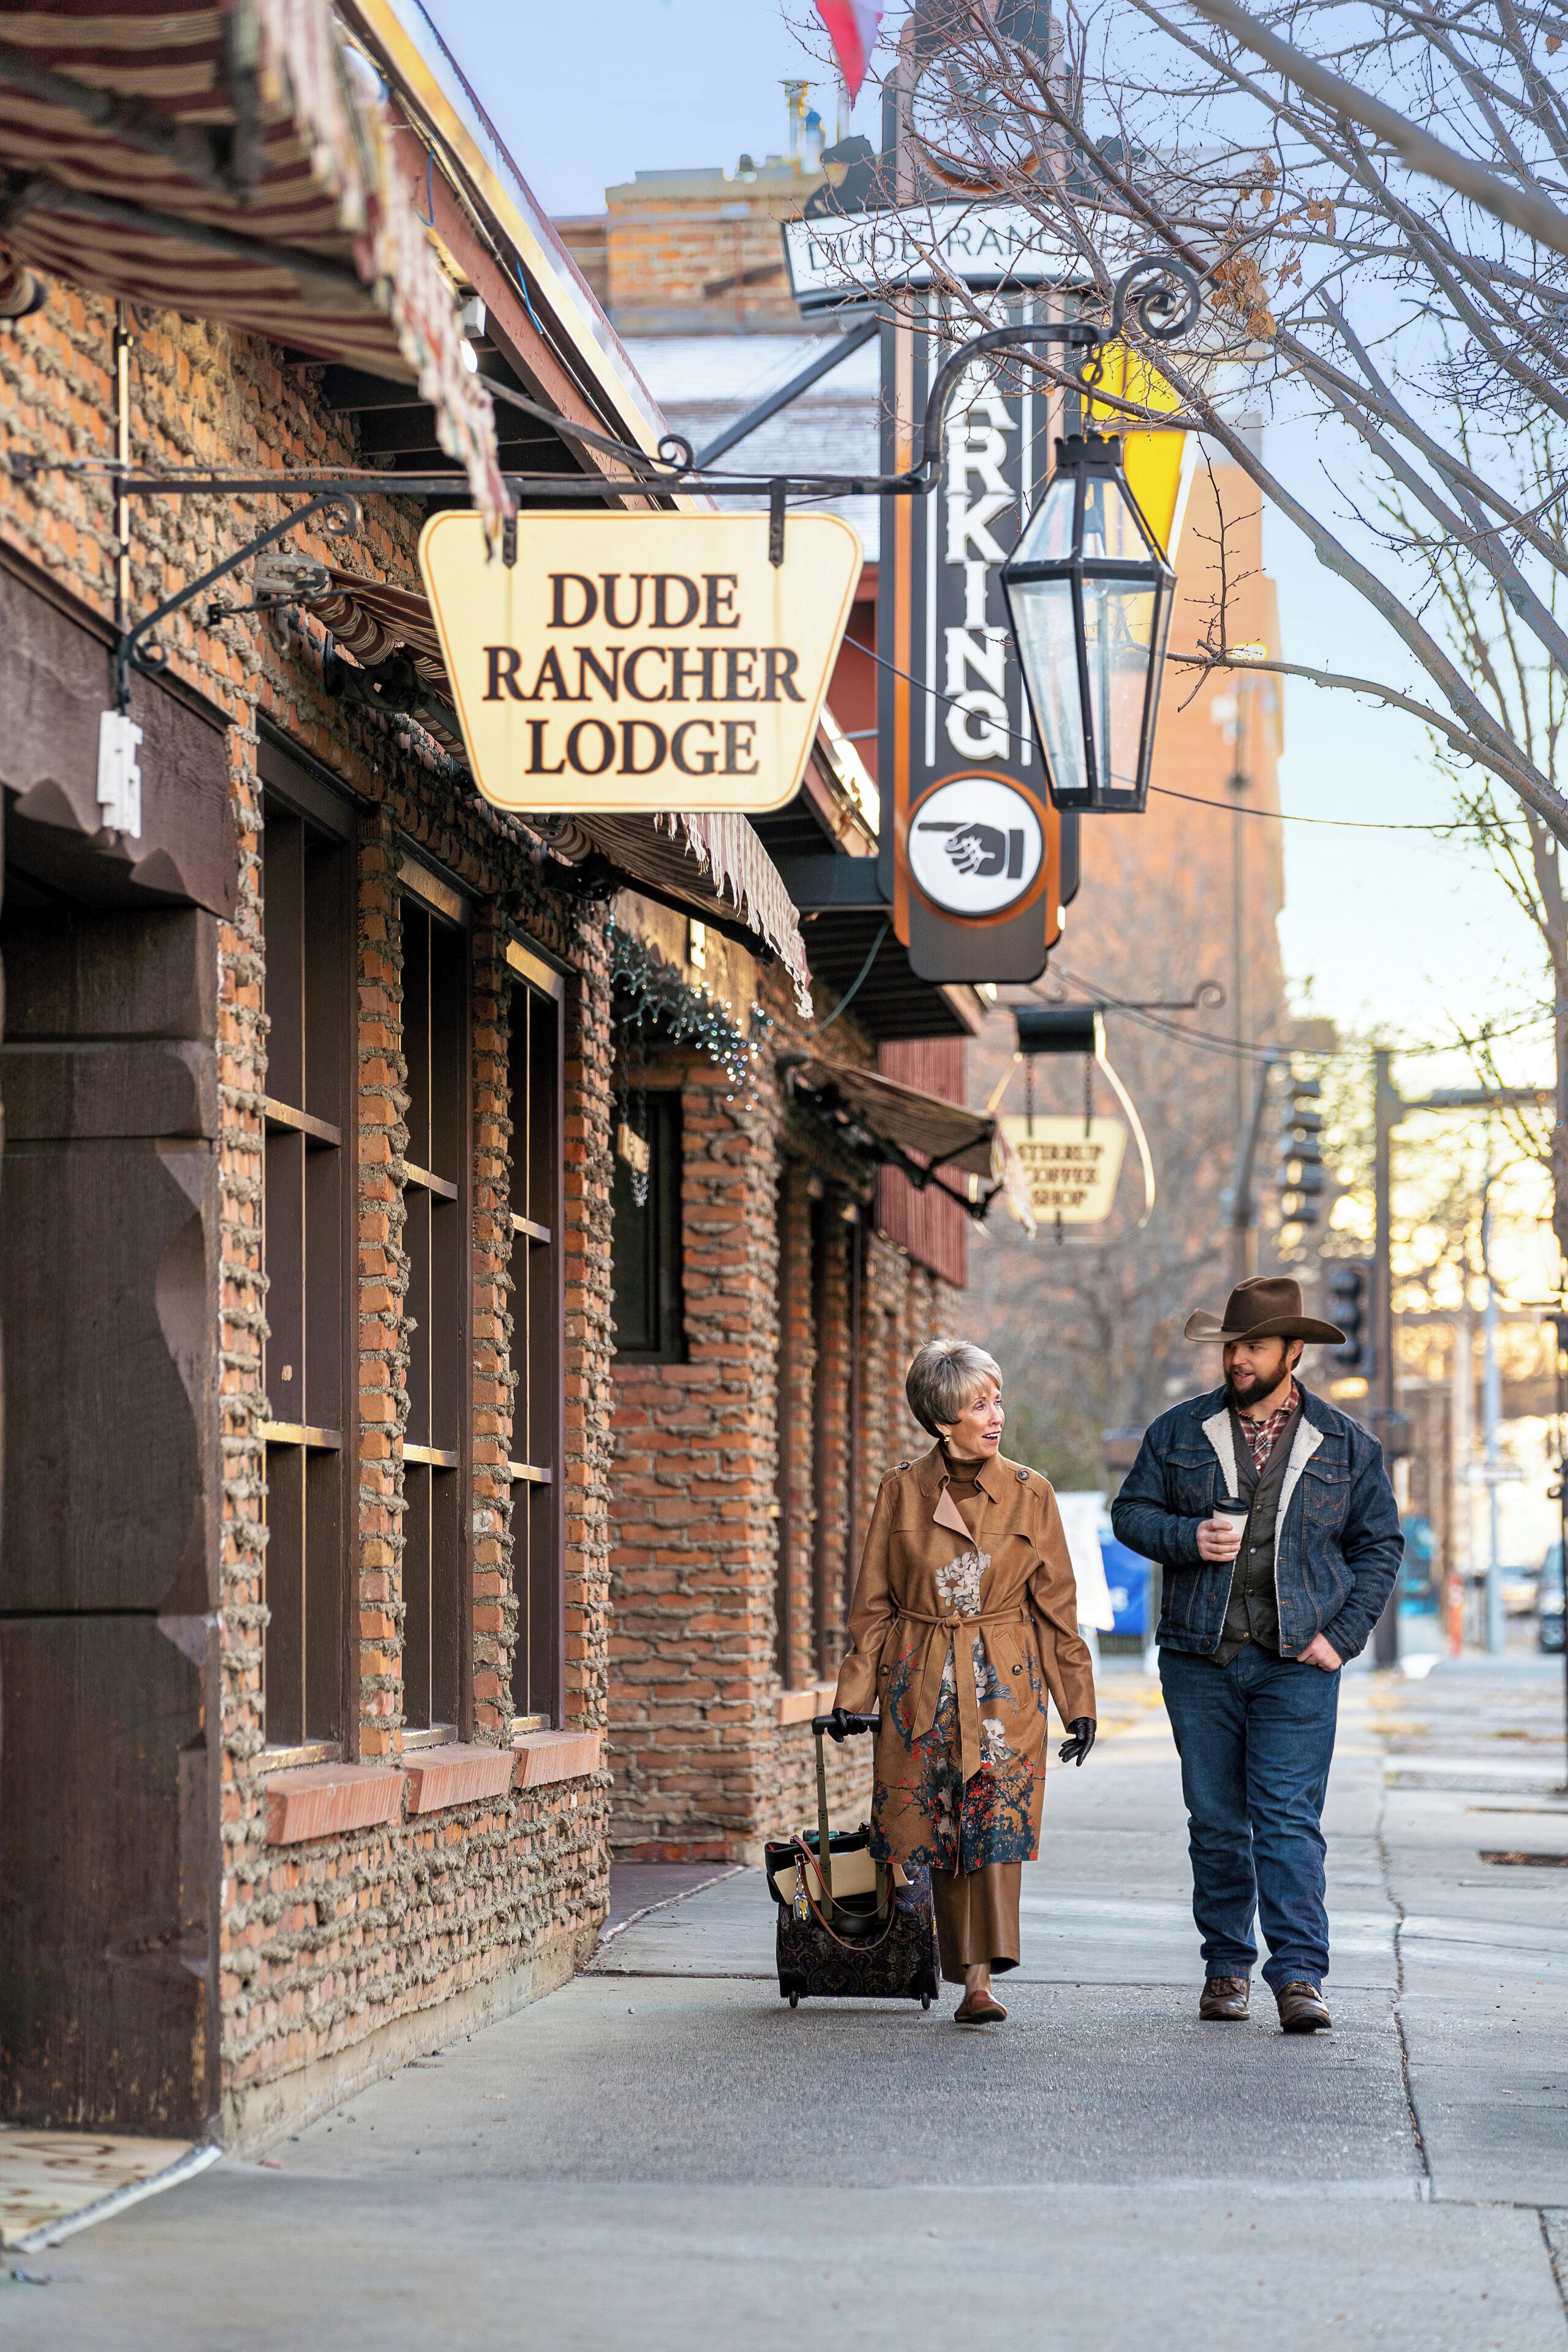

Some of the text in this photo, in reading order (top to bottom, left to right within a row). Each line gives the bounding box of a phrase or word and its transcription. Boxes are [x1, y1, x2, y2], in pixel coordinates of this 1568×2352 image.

[808, 229, 924, 271] DUDE
[944, 294, 1019, 760] PARKING
[546, 573, 741, 630] DUDE
[482, 645, 806, 703] RANCHER
[524, 718, 760, 776] LODGE
